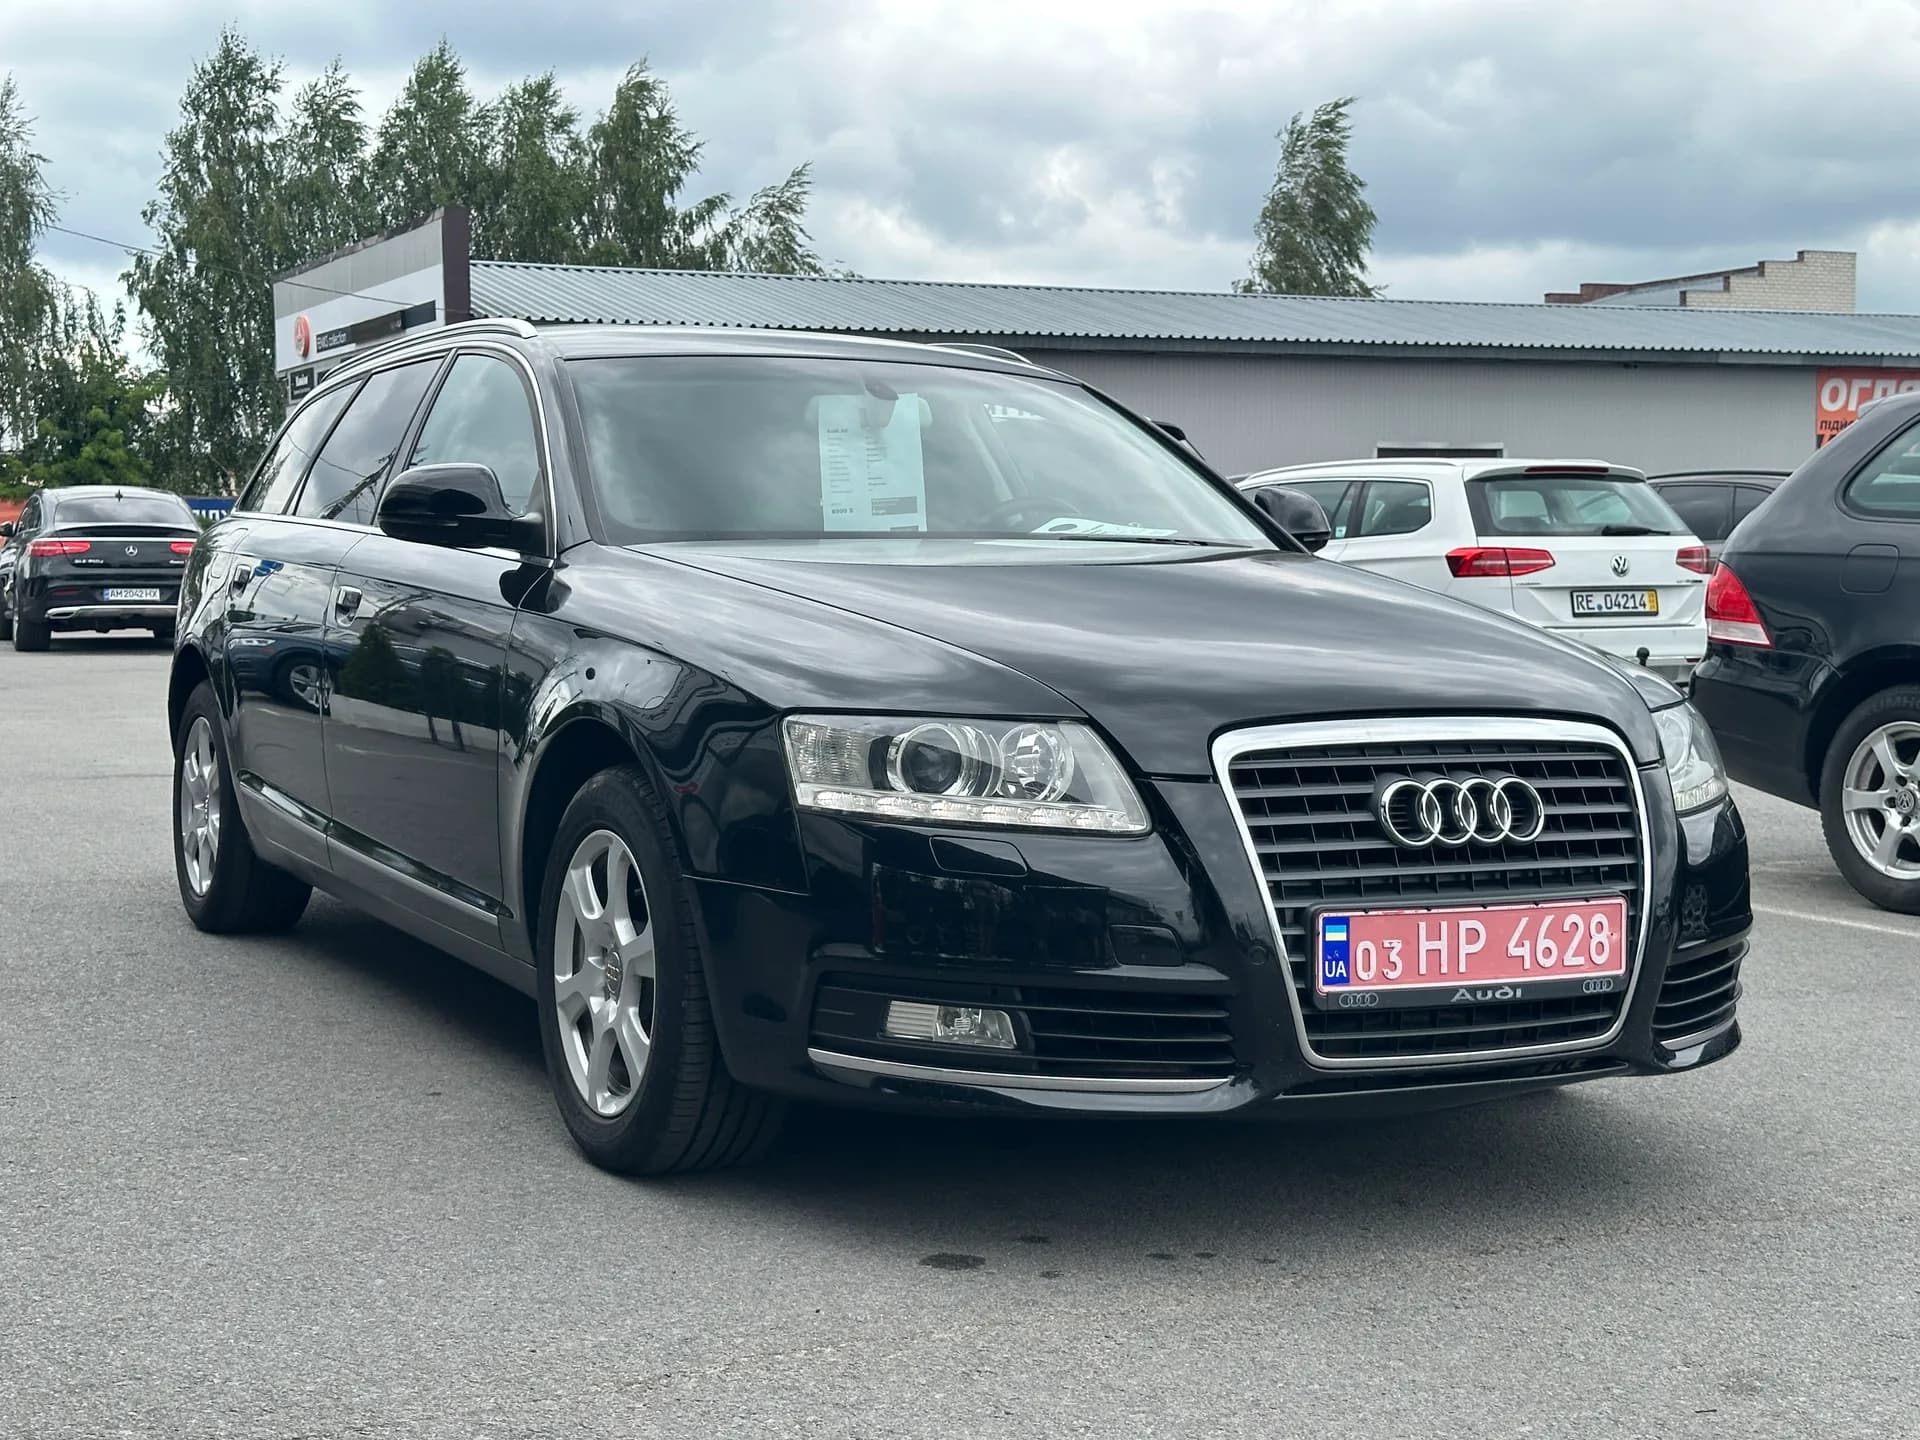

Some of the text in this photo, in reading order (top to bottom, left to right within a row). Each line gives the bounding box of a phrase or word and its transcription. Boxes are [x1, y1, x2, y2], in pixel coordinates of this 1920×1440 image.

[1355, 912, 1611, 982] 03 HP 4628
[1324, 960, 1347, 979] UA
[1450, 985, 1522, 1004] Audi
